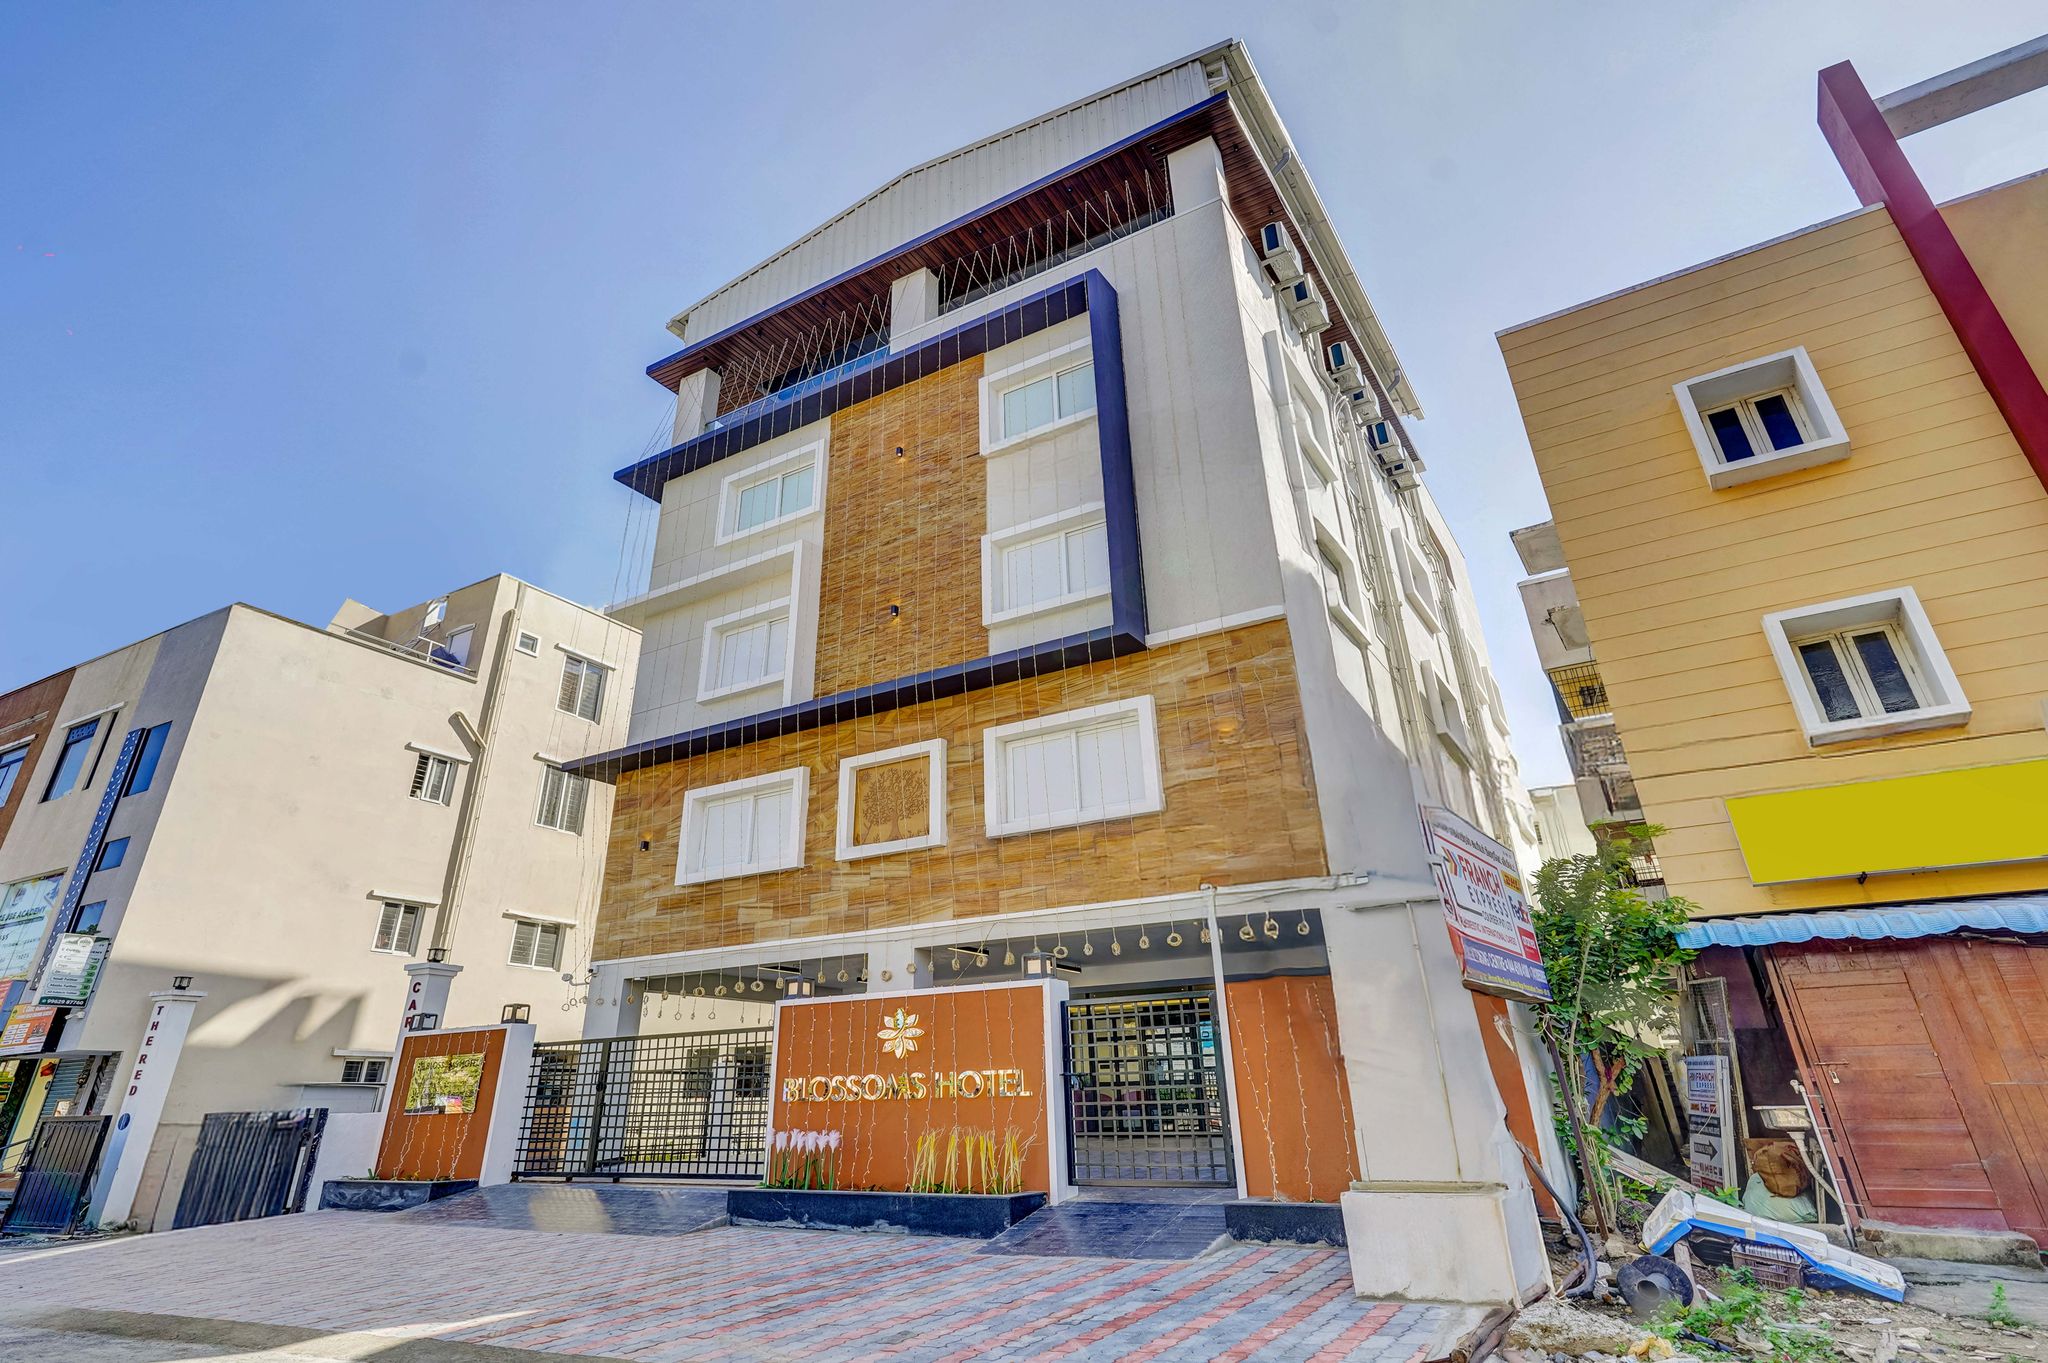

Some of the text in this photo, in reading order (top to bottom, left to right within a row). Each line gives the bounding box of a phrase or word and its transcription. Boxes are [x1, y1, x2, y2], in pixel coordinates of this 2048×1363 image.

[1458, 855, 1503, 896] FRANCH
[1468, 886, 1509, 917] EXPRESS
[1508, 895, 1530, 925] FedEx
[783, 1069, 1032, 1102] BLOSSOMS HOTEL
